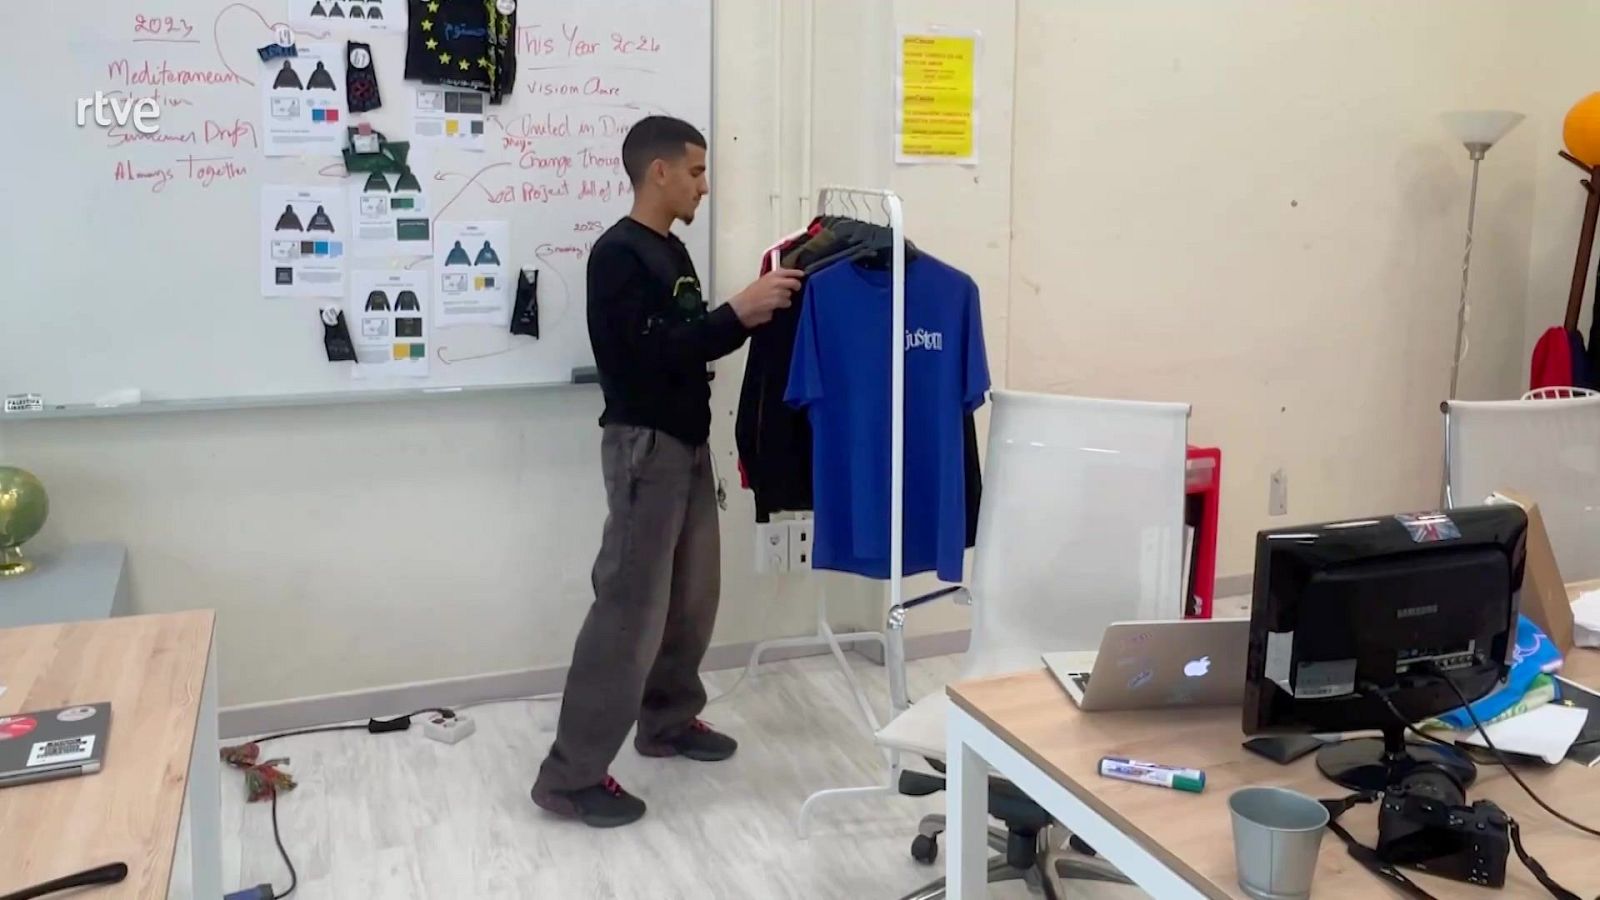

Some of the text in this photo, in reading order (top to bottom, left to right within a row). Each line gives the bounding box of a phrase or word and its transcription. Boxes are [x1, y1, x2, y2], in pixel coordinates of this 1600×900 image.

[515, 25, 554, 55] This
[562, 23, 600, 58] Year
[519, 150, 572, 178] Change
